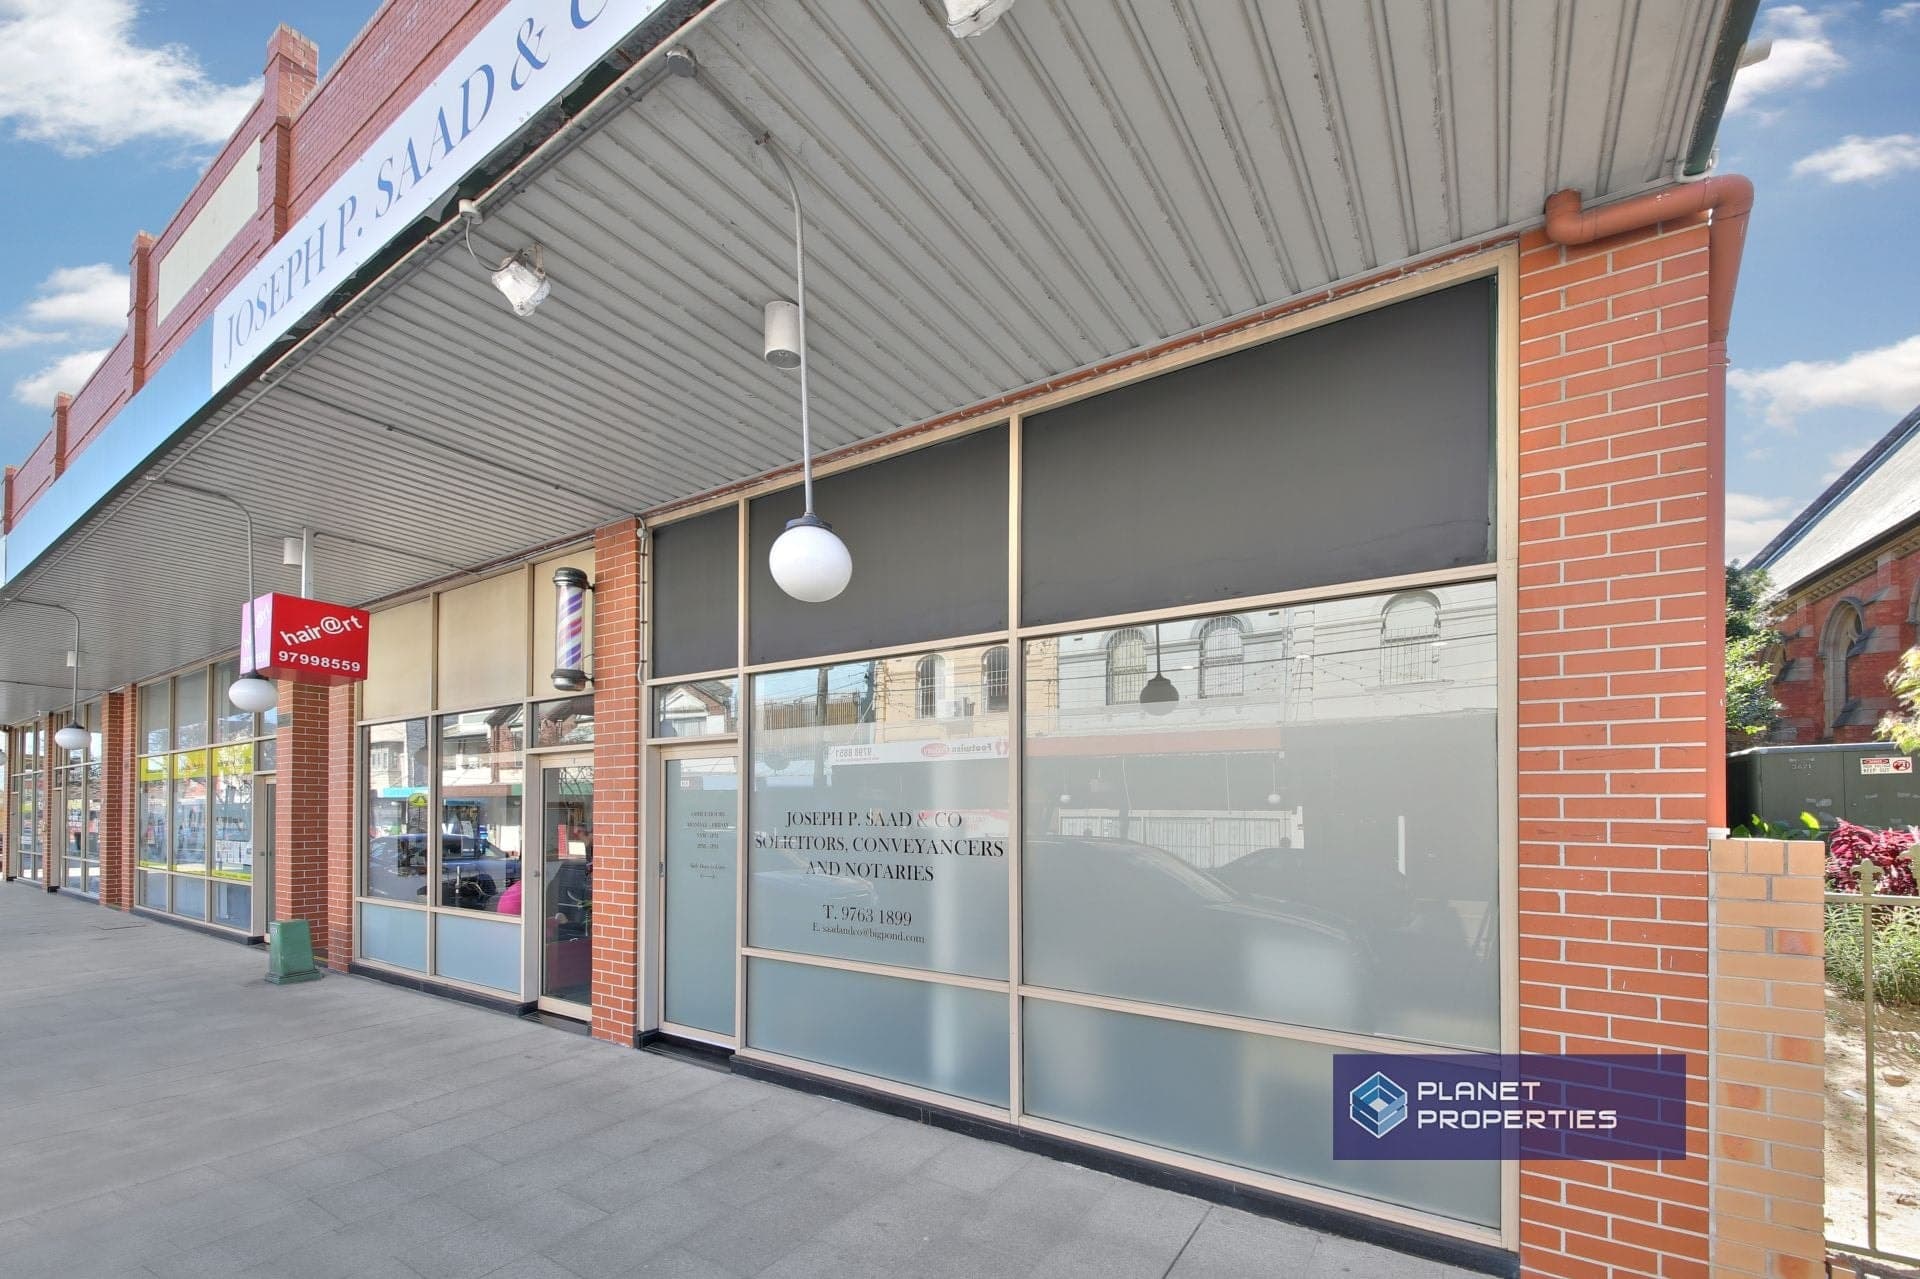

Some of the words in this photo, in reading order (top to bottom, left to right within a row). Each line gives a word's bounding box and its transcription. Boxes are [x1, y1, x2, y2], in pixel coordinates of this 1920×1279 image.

[224, 228, 328, 369] JOSEPH
[337, 195, 362, 254] P.
[375, 64, 495, 219] SAAD
[511, 18, 550, 91] &
[280, 615, 363, 646] hair@rt
[278, 651, 361, 672] 97998559
[785, 811, 843, 827] JOSEPH
[849, 811, 860, 827] P.
[866, 811, 912, 828] SAAD
[917, 812, 928, 828] &
[934, 812, 962, 828] CO
[755, 835, 849, 852] SOLICITORS,
[853, 836, 1004, 857] CONVEYANCERS
[806, 860, 840, 876] AND
[845, 862, 935, 881] NOTARIES
[823, 904, 837, 920] T.
[841, 906, 874, 923] 9763
[879, 909, 912, 927] 1899
